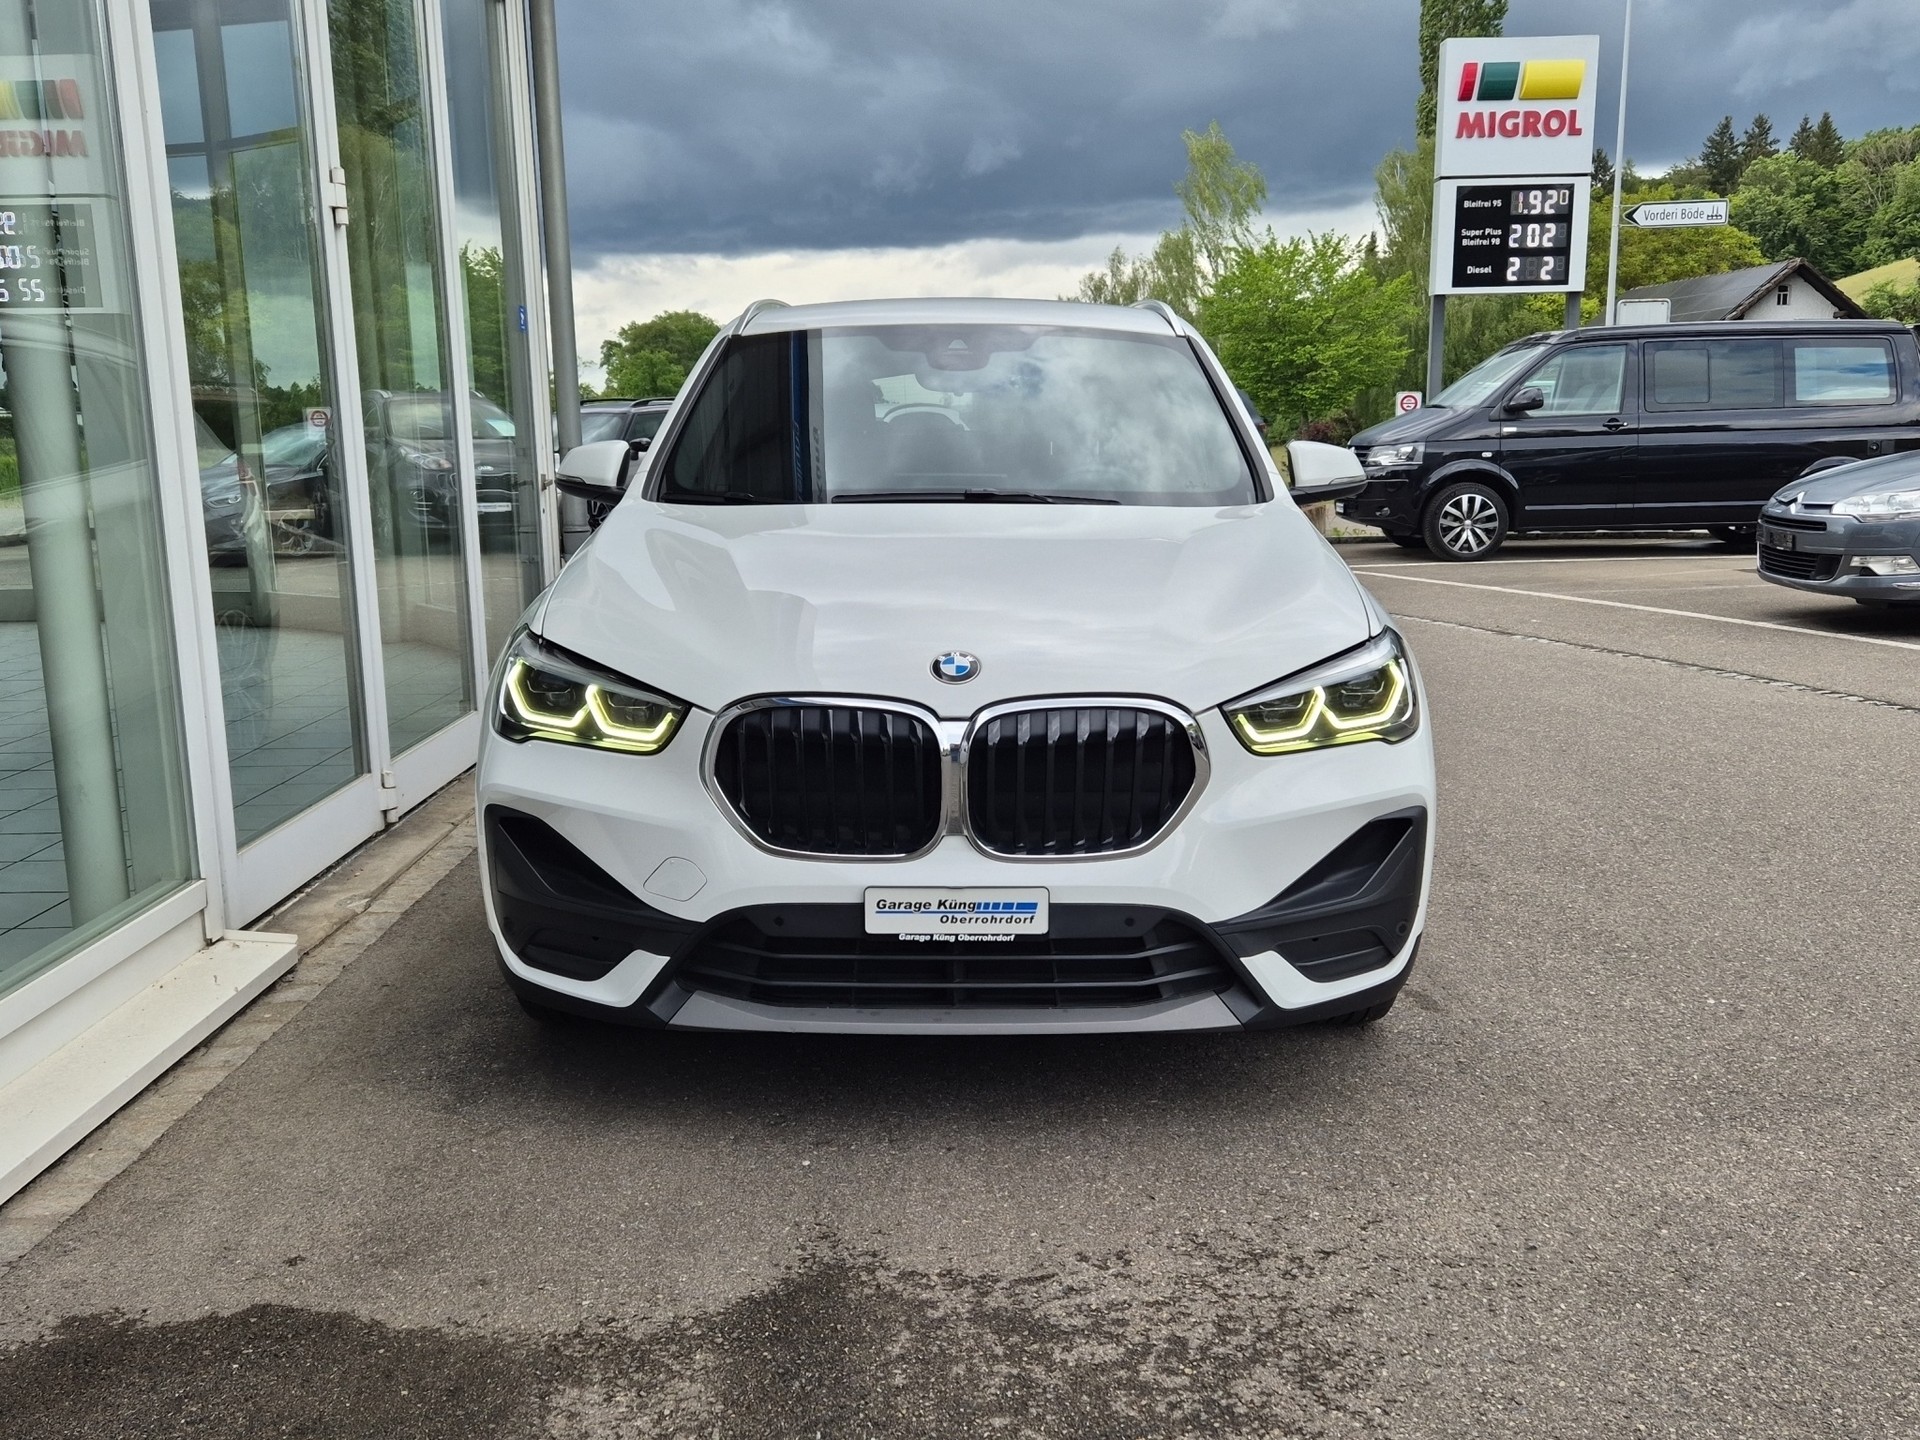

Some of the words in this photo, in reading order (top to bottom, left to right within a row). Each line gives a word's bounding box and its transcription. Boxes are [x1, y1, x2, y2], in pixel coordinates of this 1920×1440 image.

[1456, 109, 1582, 139] MIGROL
[1464, 200, 1491, 208] Bleifrei
[1643, 208, 1678, 221] Vorderi
[1461, 228, 1484, 238] Super
[1485, 227, 1502, 236] Plus
[1462, 238, 1489, 246] Bleifrei
[1490, 237, 1500, 246] 98
[1467, 265, 1492, 275] Diesel
[876, 899, 932, 912] Garage
[937, 899, 976, 912] Küng
[940, 915, 1035, 924] Oberrohrdorf
[899, 933, 931, 942] Garage
[933, 933, 955, 942] Küng
[958, 933, 1015, 942] Oberrohrdorf
